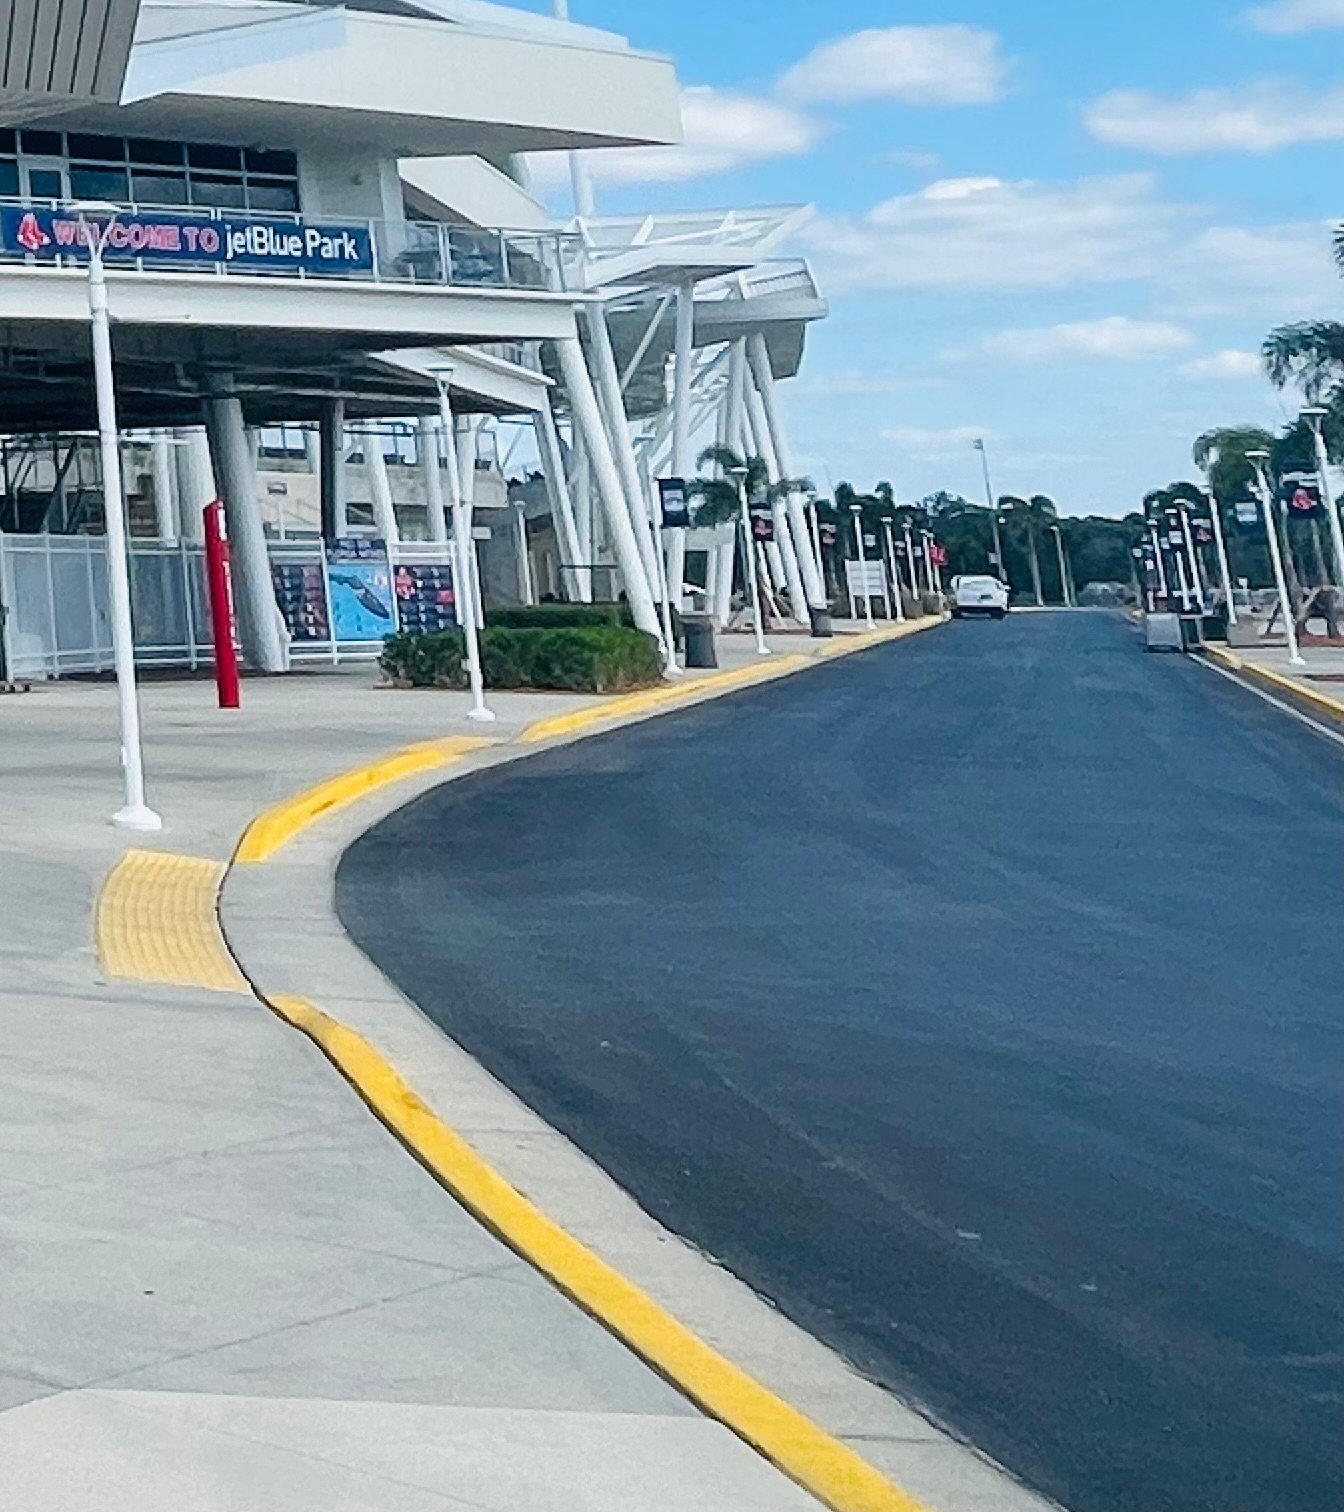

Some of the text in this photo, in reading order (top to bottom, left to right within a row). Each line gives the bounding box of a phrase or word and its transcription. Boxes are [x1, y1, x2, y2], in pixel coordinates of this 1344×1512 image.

[52, 219, 359, 260] WELCOME TO jetBlue Park
